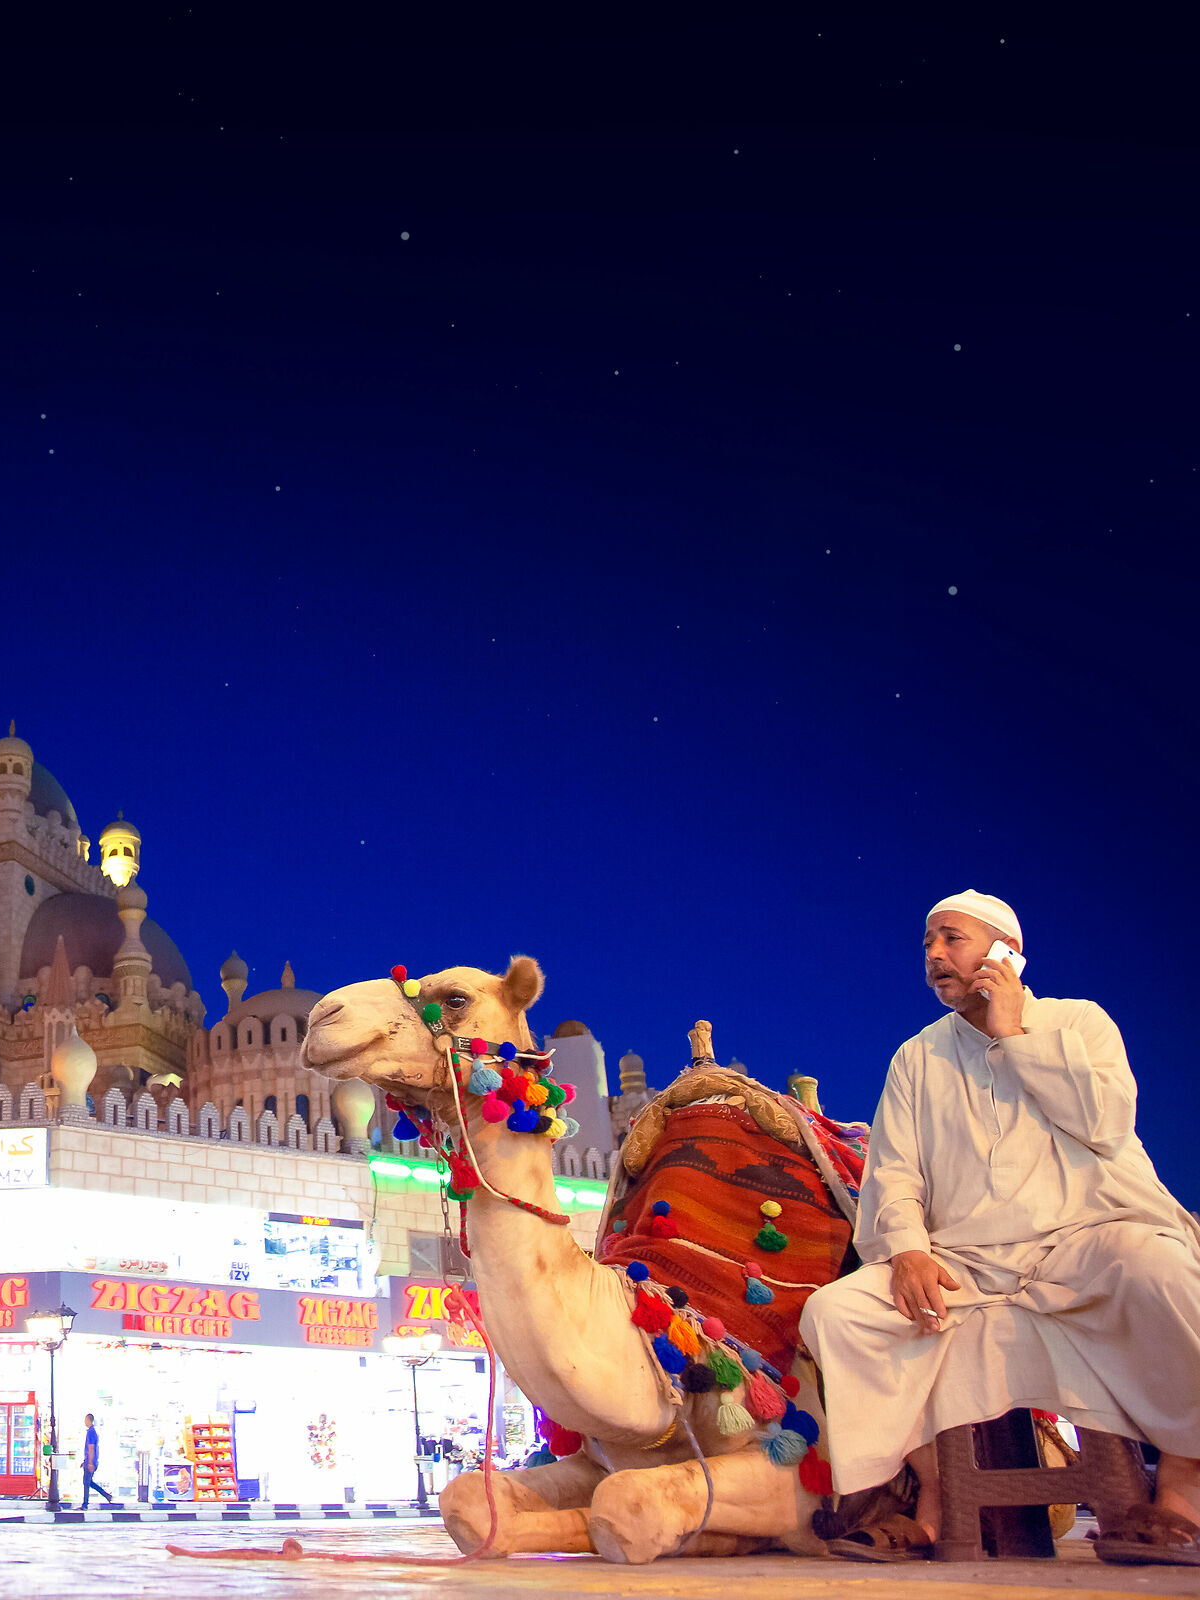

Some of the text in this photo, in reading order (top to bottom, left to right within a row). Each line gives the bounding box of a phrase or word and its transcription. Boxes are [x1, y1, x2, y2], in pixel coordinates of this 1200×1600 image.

[91, 1280, 261, 1321] ZIGZAG
[299, 1298, 378, 1330] ZIGZAG
[122, 1314, 232, 1338] MARKET & GIFTS
[307, 1327, 374, 1347] ACCESSORIES
